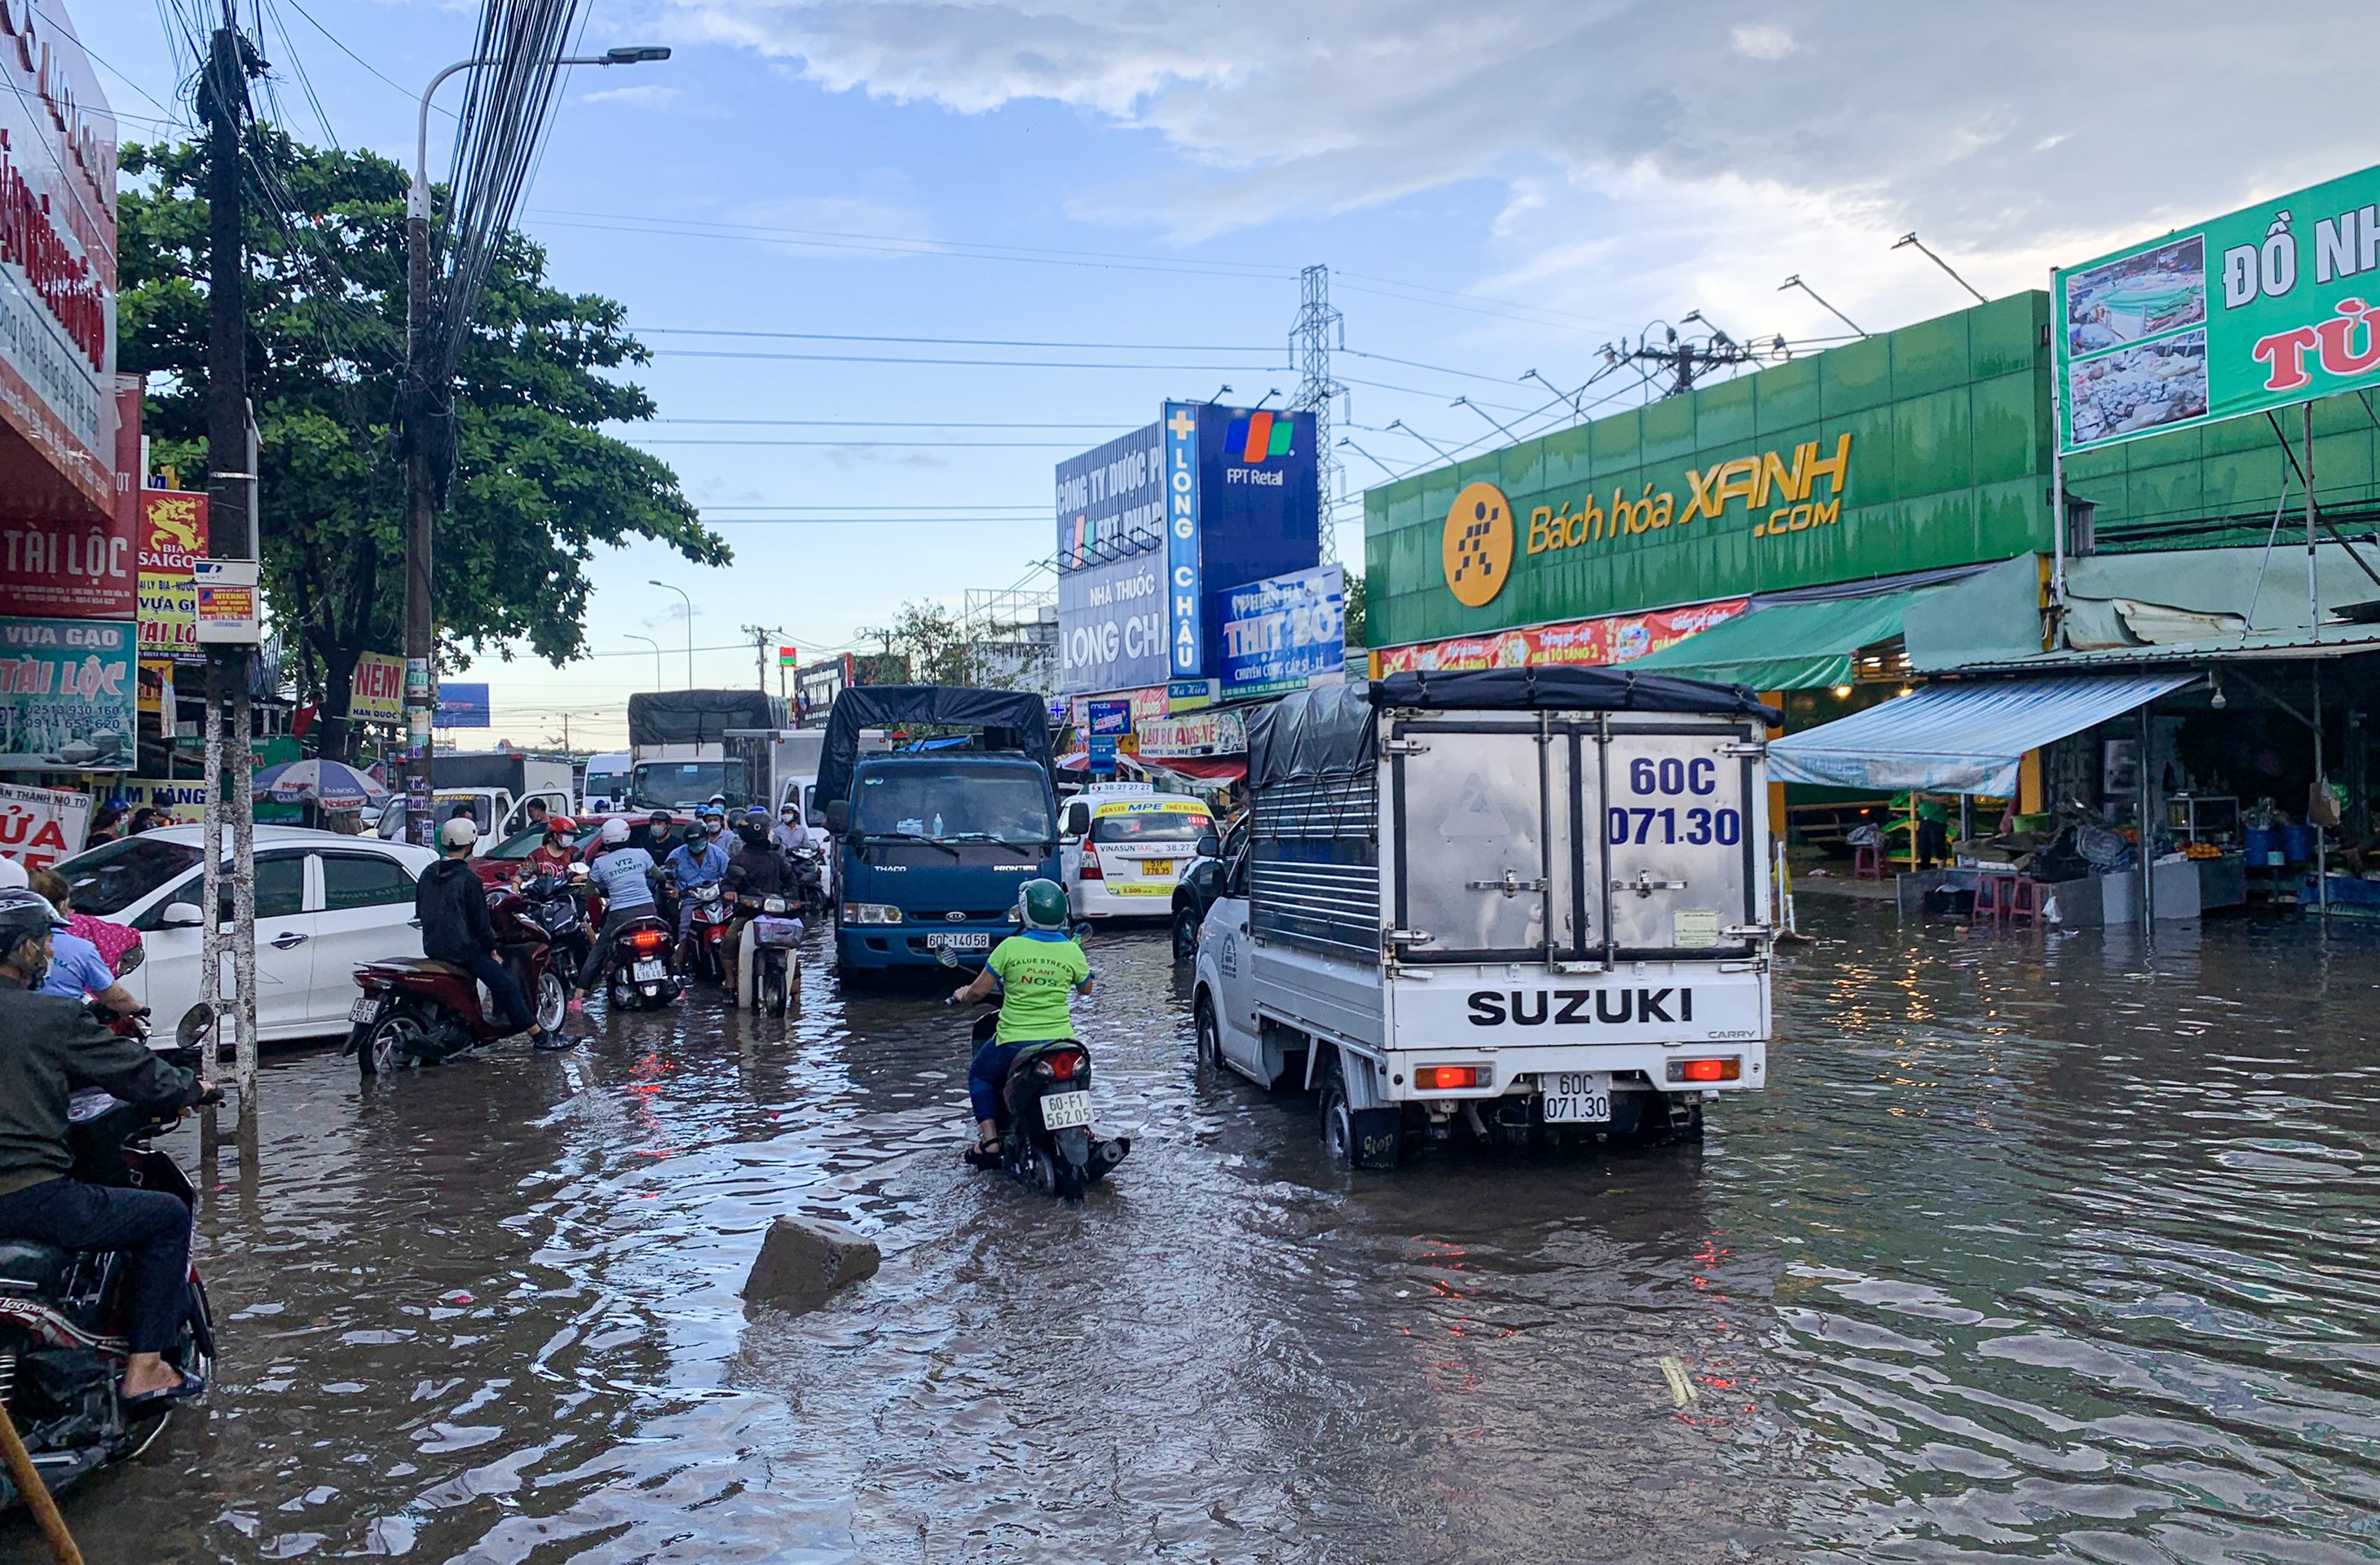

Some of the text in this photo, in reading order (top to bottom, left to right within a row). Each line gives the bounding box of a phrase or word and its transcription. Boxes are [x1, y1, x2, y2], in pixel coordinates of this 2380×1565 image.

[2222, 209, 2297, 311] ĐỒ
[1057, 473, 1088, 517] CÔNG
[1088, 467, 1106, 504] TY
[1108, 448, 1147, 500] DƯỢC
[1227, 468, 1250, 484] FPT
[1527, 433, 1852, 555] Bách hóa XANH
[1753, 497, 1841, 538] .COM
[1095, 514, 1121, 554] FPT
[3, 522, 128, 585] TÀI LỘC
[163, 544, 185, 553] BIA
[1173, 448, 1195, 668] LONG CHÂU
[158, 580, 170, 590] BIA
[1090, 564, 1156, 608] NHÀ THUỐC
[139, 596, 174, 616] VỰA
[4, 625, 119, 650] VỰA GẠO
[138, 617, 169, 642] TÀI
[1223, 611, 1286, 663] THỊT
[1063, 620, 1121, 669] LONG
[1550, 648, 1562, 662] 10
[1564, 648, 1589, 663] TẶNG
[1590, 644, 1598, 659] 2
[0, 654, 55, 694] TÀI
[60, 654, 127, 702] LỘC
[355, 657, 400, 705] NỆM
[1234, 663, 1263, 681] CHUYÊN
[25, 704, 64, 716] 02513
[68, 706, 92, 716] 930
[97, 707, 120, 716] 160
[25, 718, 121, 729] 0914 654 620
[1128, 783, 1139, 791] 27
[1629, 757, 1716, 796] 60C
[74, 797, 88, 809] TÔ
[1127, 803, 1164, 811] MPE
[1608, 806, 1741, 846] 071.30
[615, 857, 634, 868] VT2
[949, 913, 963, 921] KIA
[1020, 975, 1058, 987] NOS
[1026, 967, 1056, 976] PLANT
[1467, 987, 1693, 1026] SUZUKI
[1708, 1029, 1756, 1039] CARRY
[1558, 1073, 1593, 1096] 60C
[1048, 1094, 1083, 1113] 60-F1
[1547, 1096, 1607, 1119] 071.30
[1047, 1108, 1091, 1128] 562.05
